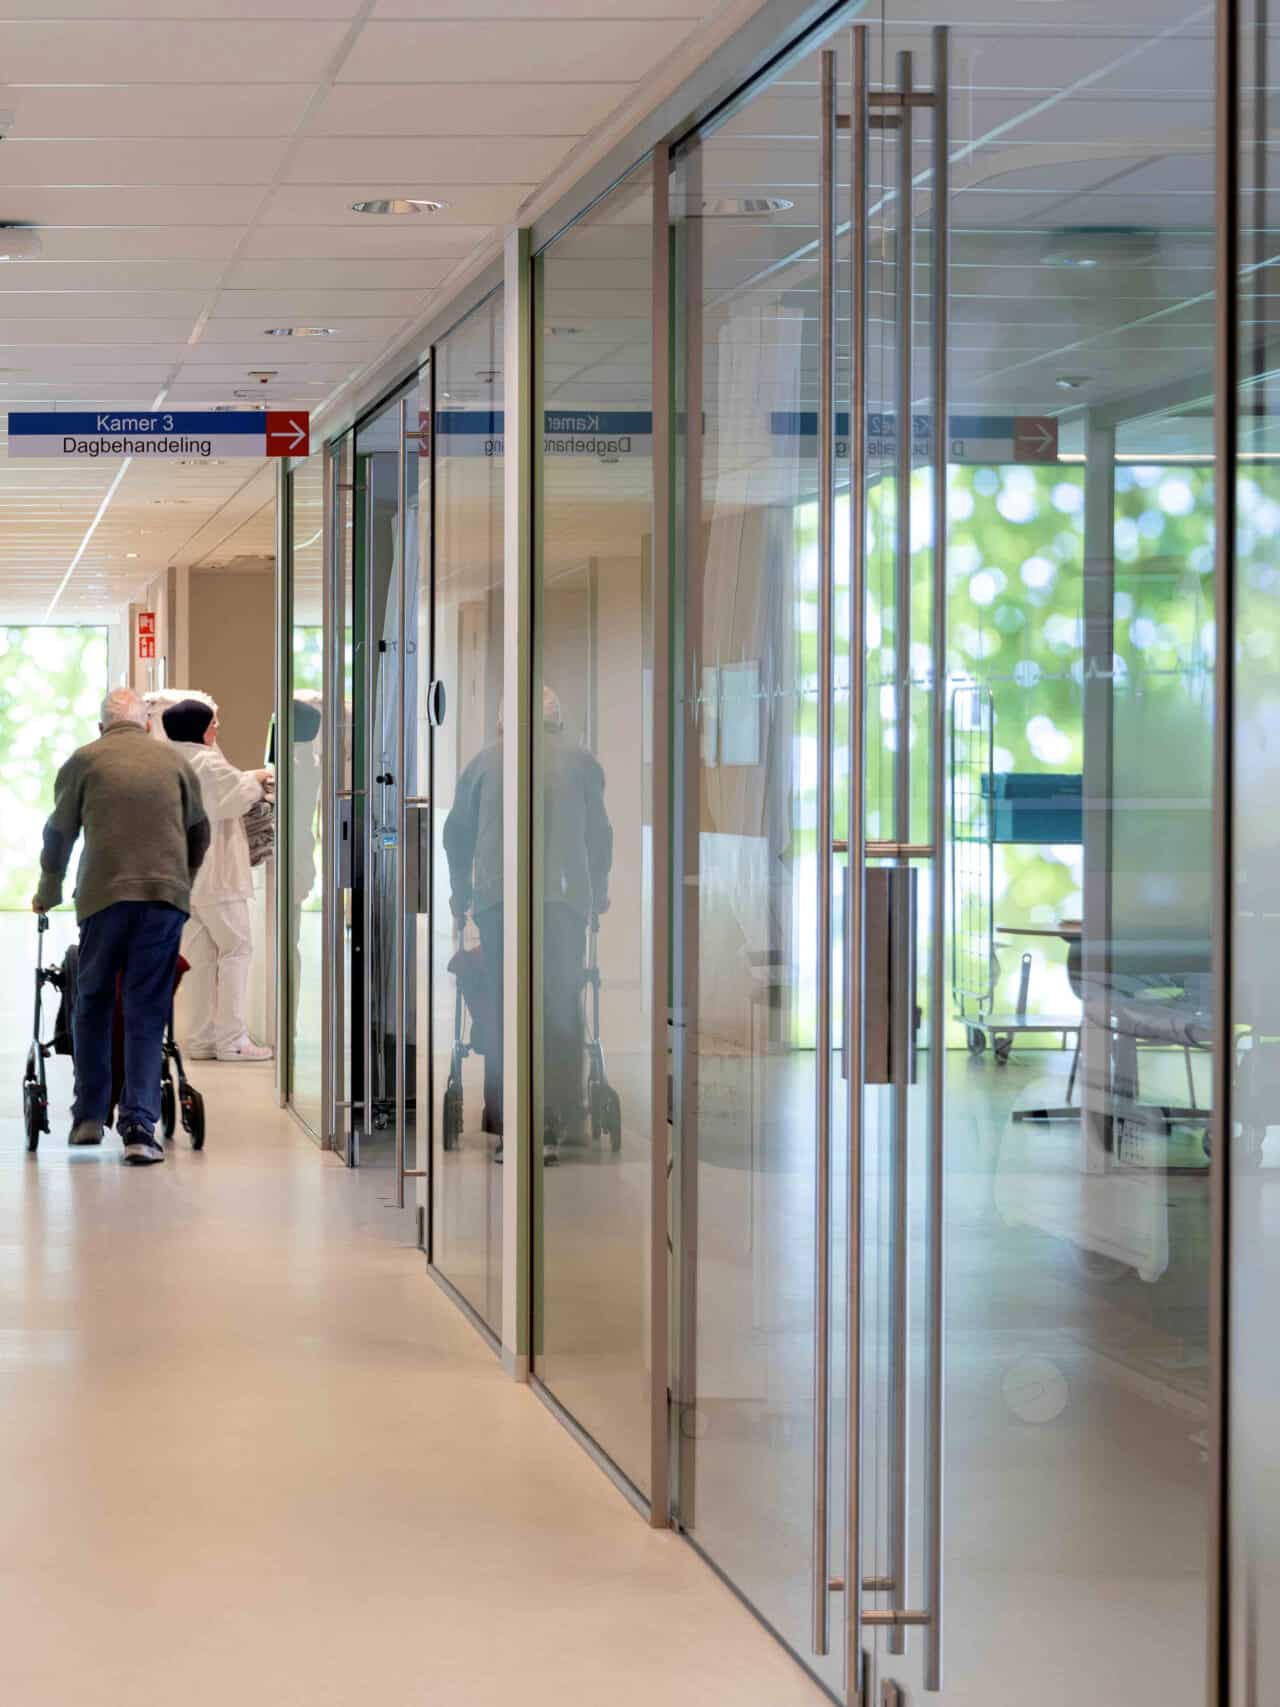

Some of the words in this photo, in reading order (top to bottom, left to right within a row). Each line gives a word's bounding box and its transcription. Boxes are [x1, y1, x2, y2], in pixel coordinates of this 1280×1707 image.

[96, 415, 157, 432] Kamer
[162, 415, 174, 432] 3
[62, 437, 212, 456] Dagbehandeling
